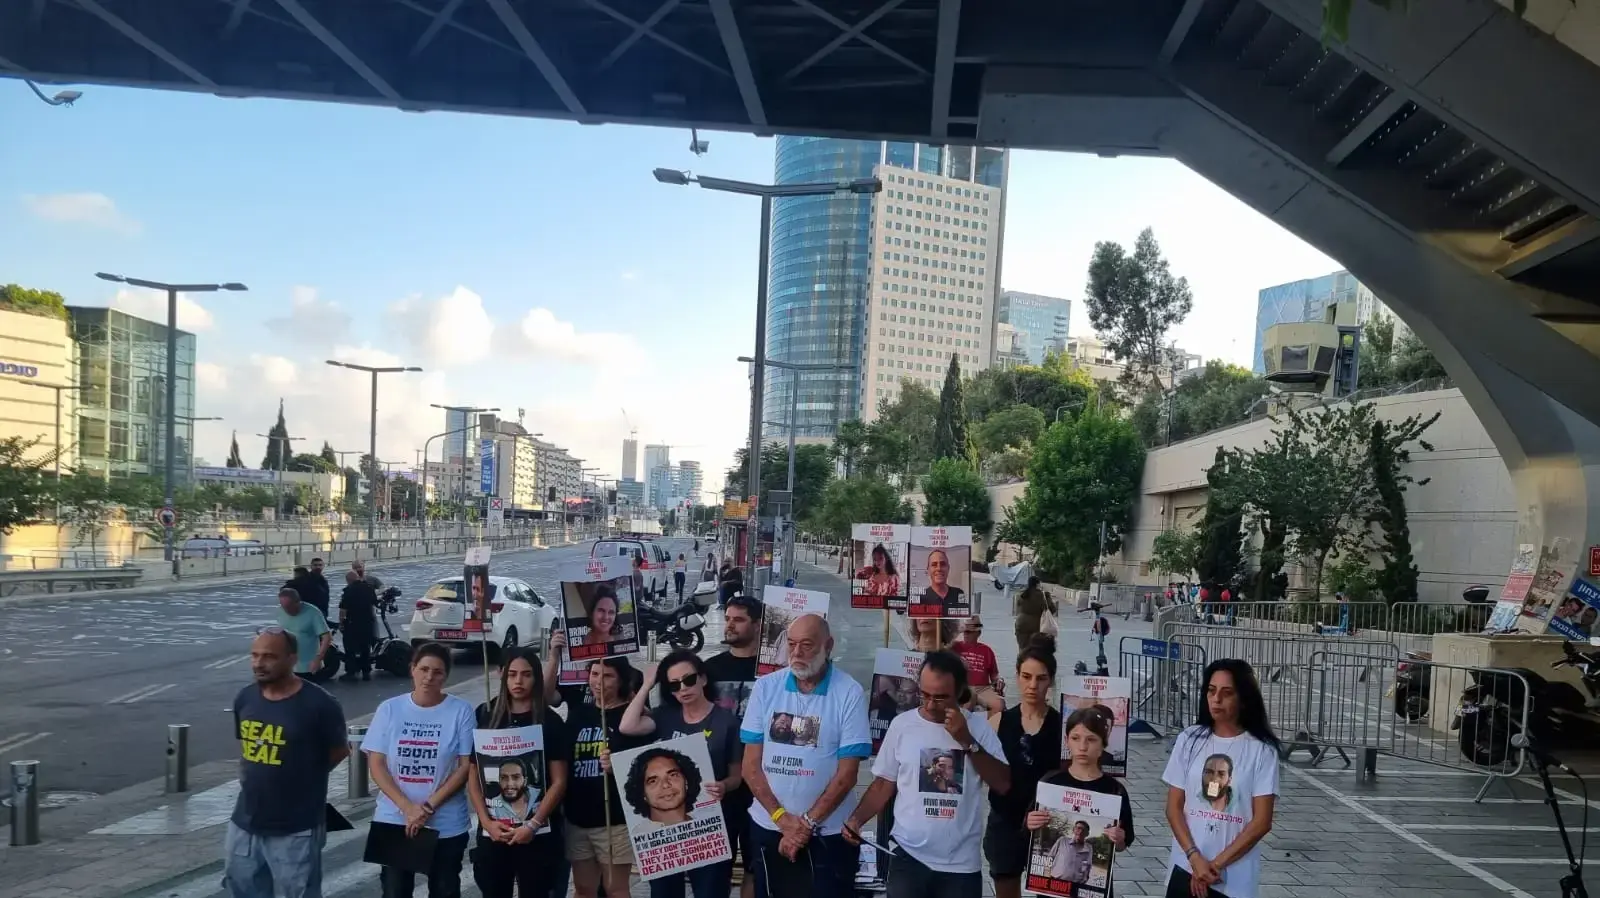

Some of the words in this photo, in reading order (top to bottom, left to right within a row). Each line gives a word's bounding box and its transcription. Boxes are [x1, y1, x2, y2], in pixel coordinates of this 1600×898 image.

[240, 720, 287, 745] SEAL
[397, 747, 438, 759] נחטפו
[782, 756, 787, 765] Y
[399, 764, 435, 776] נרצחו
[925, 807, 939, 816] HOME
[634, 834, 646, 844] MY
[648, 829, 665, 841] LIFE
[678, 822, 693, 833] THE
[694, 816, 721, 829] HANDS
[650, 835, 677, 849] ISRAELI
[677, 823, 722, 841] GOVERNMENT
[638, 851, 646, 859] IF
[646, 847, 663, 857] THEY
[664, 843, 683, 854] DON'T
[683, 838, 700, 849] SIGN
[700, 836, 706, 844] A
[706, 832, 723, 841] DEAL
[640, 856, 661, 867] THEY
[663, 851, 680, 862] ARE
[681, 842, 712, 857] SIGNING
[713, 838, 726, 847] MY
[641, 862, 675, 876] DEATH
[676, 845, 729, 867] WARRANT!
[1031, 854, 1054, 867] BRING
[1029, 876, 1049, 889] HOME
[1050, 879, 1072, 893] NOW!
